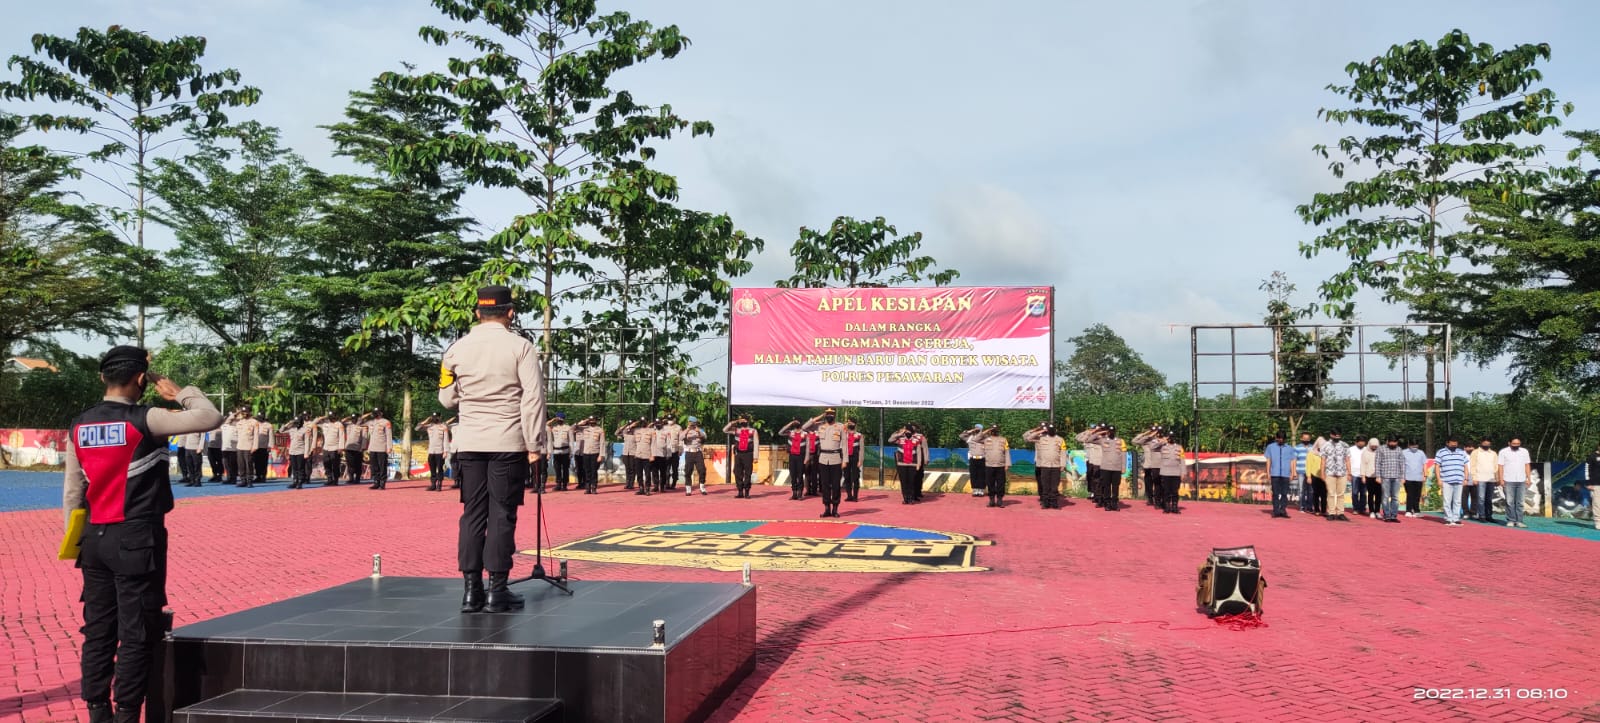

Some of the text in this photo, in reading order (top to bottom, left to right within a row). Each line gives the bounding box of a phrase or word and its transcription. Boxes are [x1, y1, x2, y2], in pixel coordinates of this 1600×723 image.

[817, 296, 972, 312] APEL KESIAPAN
[845, 322, 941, 332] DALAM RANGKA
[814, 337, 974, 351] PENGAMANAN GEREJA,
[754, 353, 1039, 366] MALAM TAHUN BARU DAN OBYEK WISATA
[821, 370, 964, 383] POLRES PESAWARAN
[80, 424, 124, 446] POLISI
